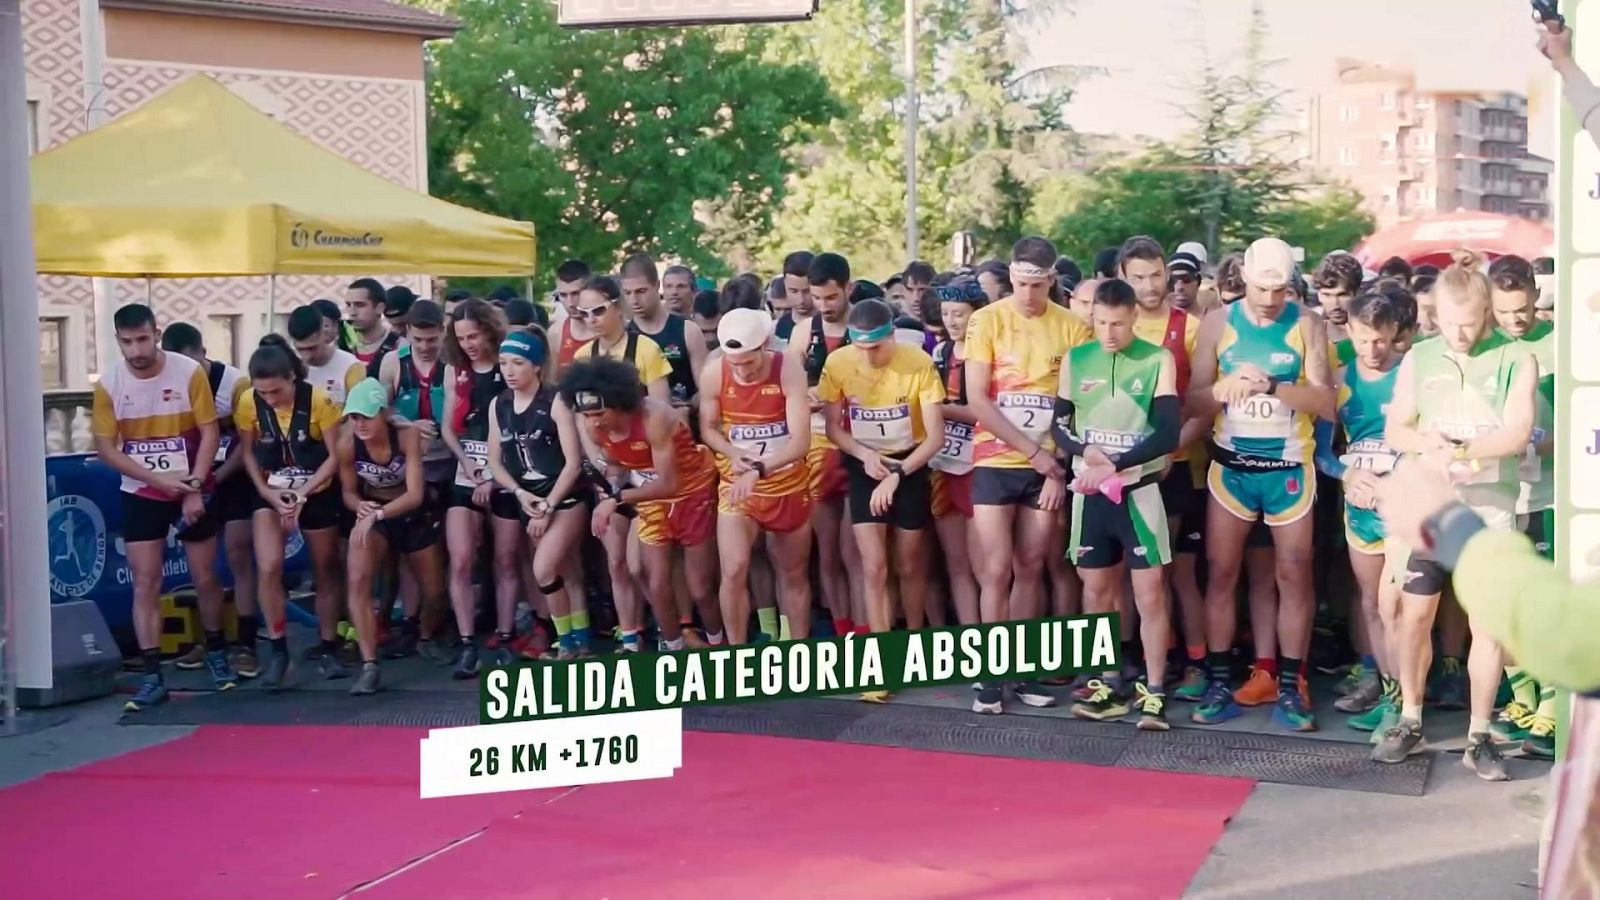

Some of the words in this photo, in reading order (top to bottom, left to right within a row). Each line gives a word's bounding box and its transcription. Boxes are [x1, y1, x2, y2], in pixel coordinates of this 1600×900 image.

[1244, 400, 1273, 419] 40
[1022, 409, 1035, 429] 2
[876, 422, 886, 437] 1
[756, 441, 767, 457] 7
[143, 454, 171, 471] 56
[1353, 455, 1374, 470] 41
